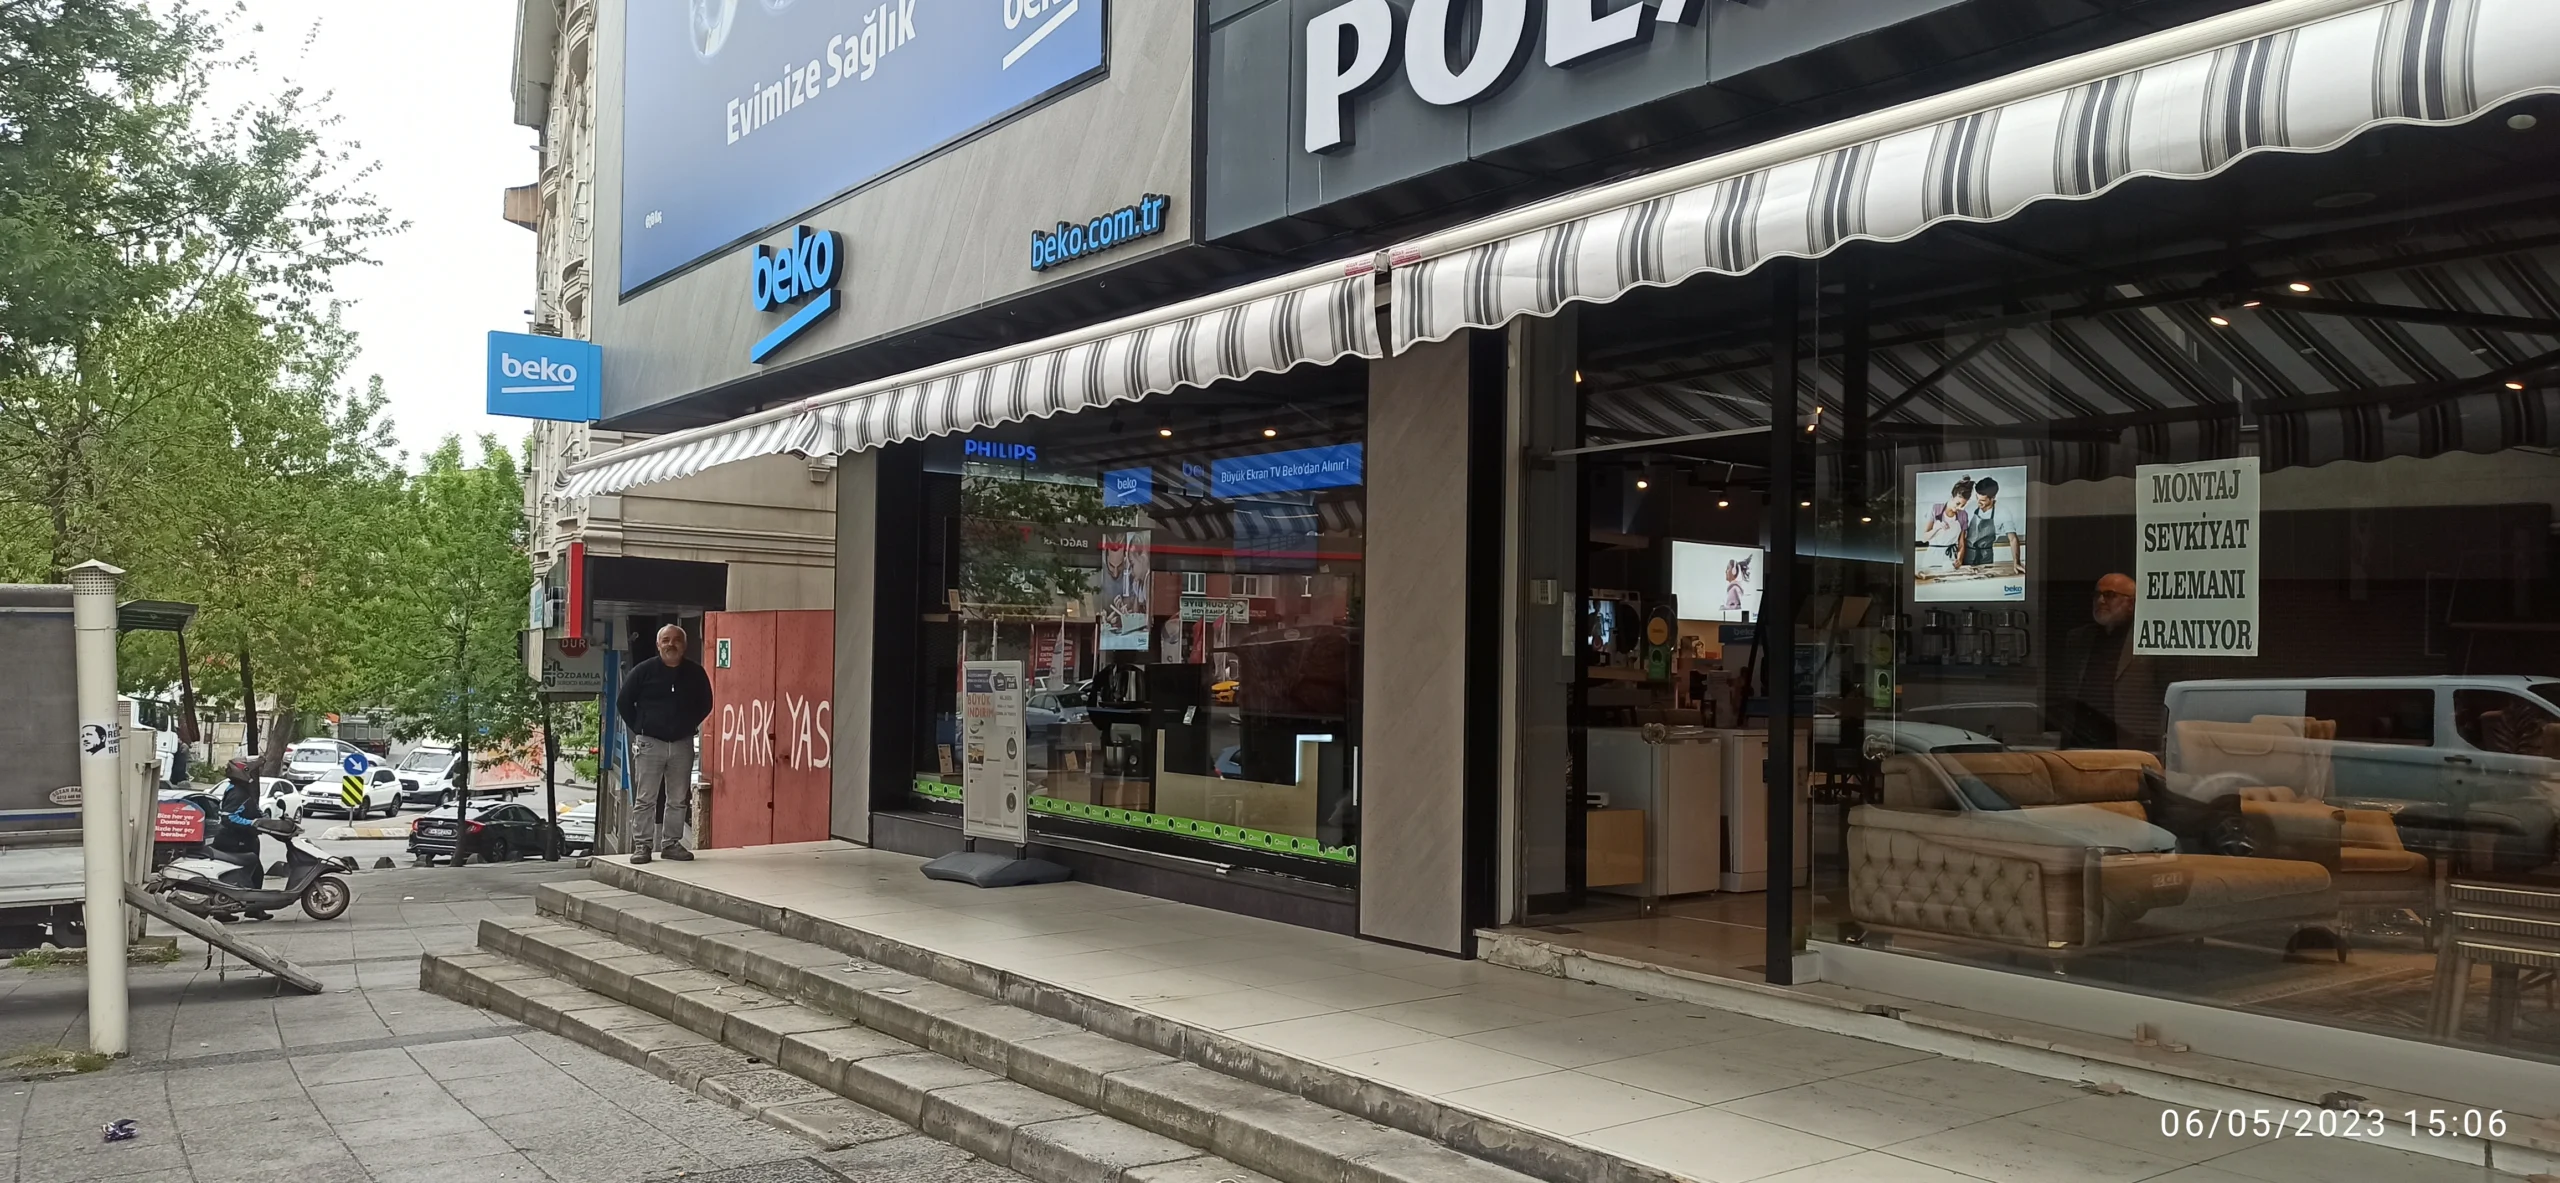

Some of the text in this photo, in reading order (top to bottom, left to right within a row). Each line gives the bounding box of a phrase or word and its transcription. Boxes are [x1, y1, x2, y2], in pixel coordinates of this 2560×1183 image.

[726, 0, 917, 146] Evimize Sağlık
[1030, 194, 1166, 270] beko.com.tr
[752, 224, 838, 312] beko
[501, 352, 578, 384] beko
[964, 439, 1037, 462] PHILIPS
[1117, 477, 1137, 490] beko
[1221, 470, 1246, 485] Büyük
[1246, 469, 1269, 481] Ekran
[1270, 466, 1281, 478] TV
[1282, 462, 1320, 477] Beko'dan
[2152, 469, 2241, 504] MONTAJ
[2144, 511, 2250, 553] SEVKİYAT
[2146, 569, 2246, 600] ELEMANI
[561, 638, 586, 648] DUR
[2137, 619, 2252, 650] ARANIYOR
[721, 699, 775, 773] PARK
